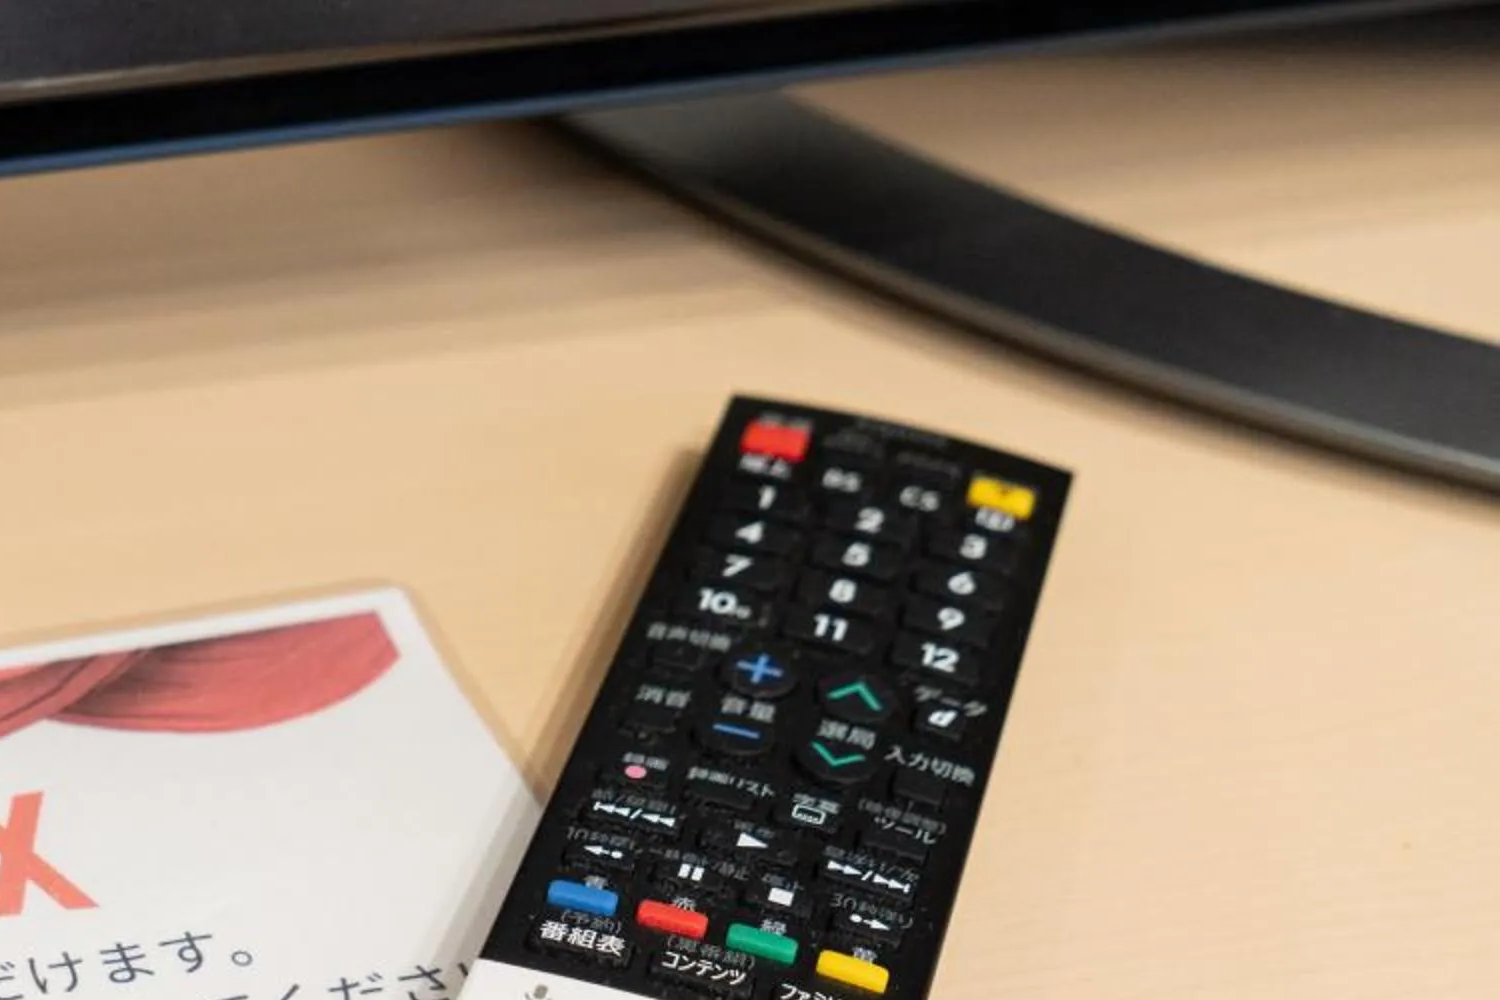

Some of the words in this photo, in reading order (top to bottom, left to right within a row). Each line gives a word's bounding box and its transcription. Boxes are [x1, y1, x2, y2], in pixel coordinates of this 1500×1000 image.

[757, 485, 777, 510] 1
[735, 521, 764, 544] 4
[855, 507, 885, 533] 2
[841, 541, 871, 567] 5
[958, 533, 987, 560] 3
[722, 554, 753, 577] 7
[829, 578, 857, 604] 8
[947, 571, 977, 596] 6
[813, 613, 850, 643] 11
[937, 607, 965, 631] 9
[920, 642, 960, 673] 12
[539, 919, 626, 957] 番組表
[661, 950, 747, 985] コンテンツ
